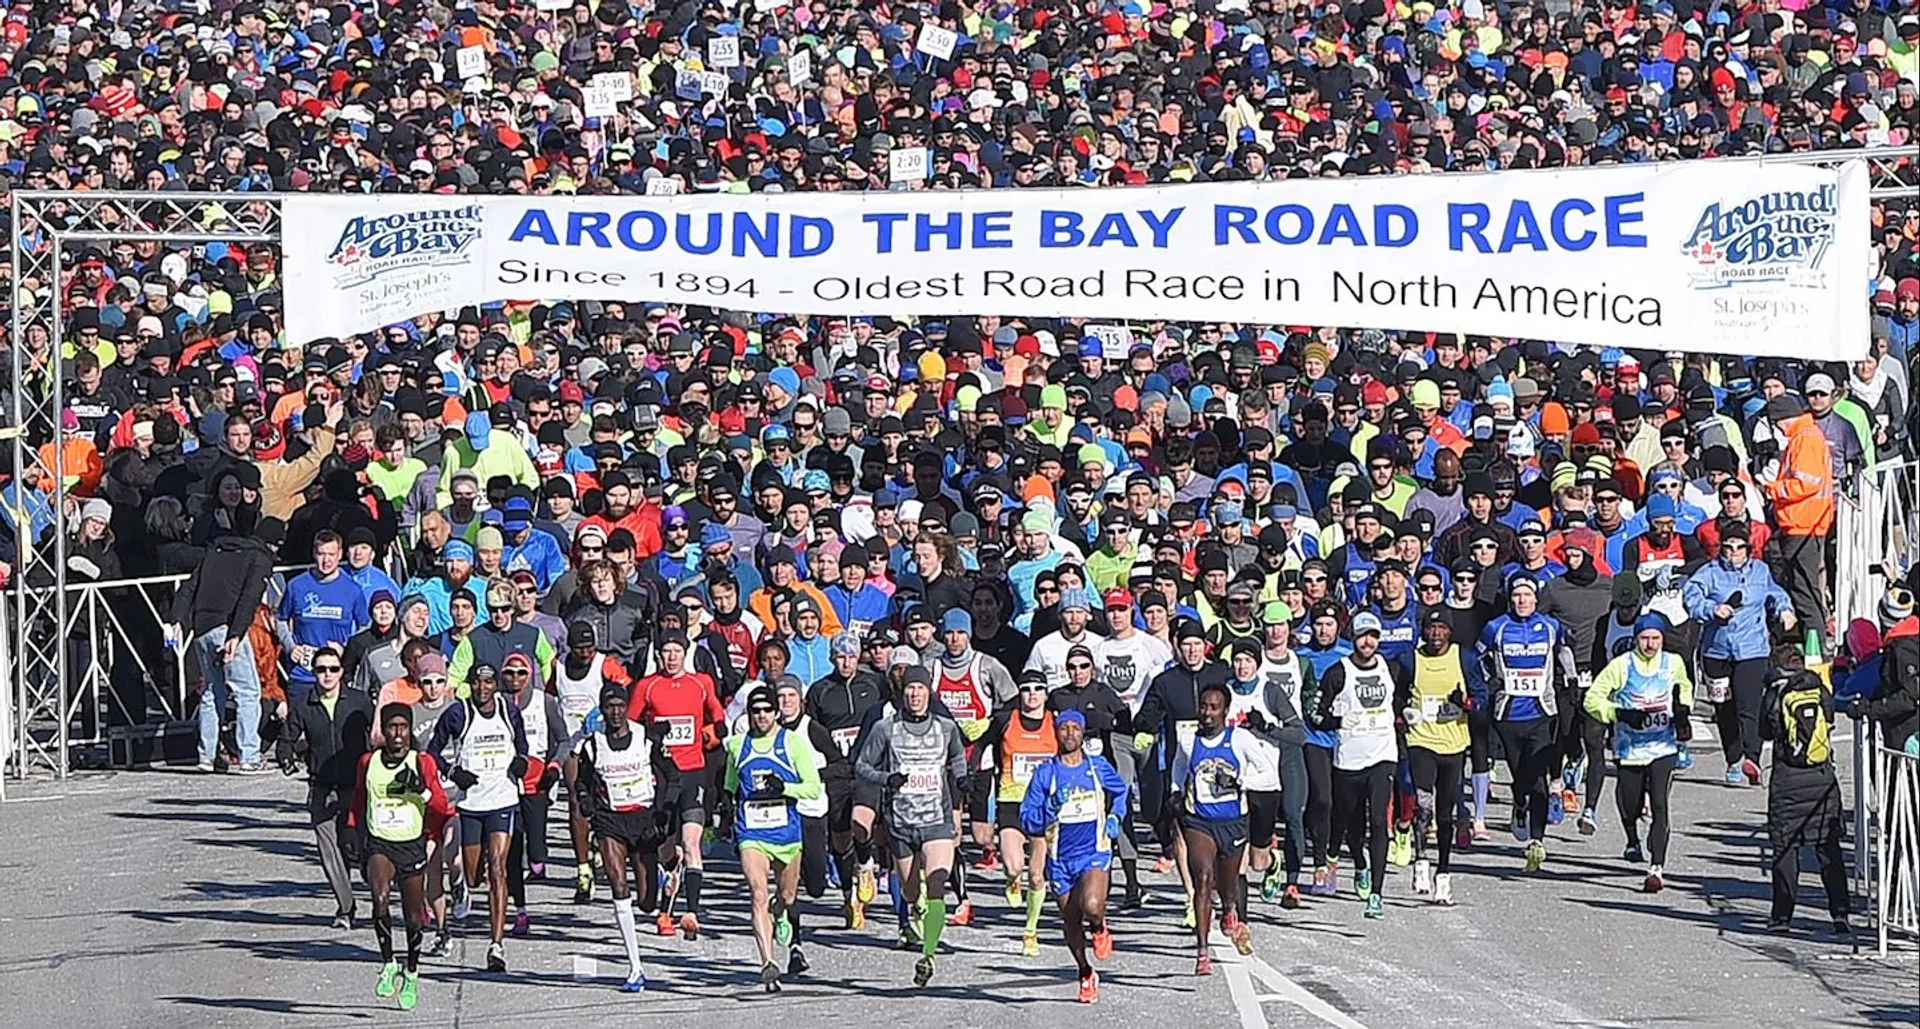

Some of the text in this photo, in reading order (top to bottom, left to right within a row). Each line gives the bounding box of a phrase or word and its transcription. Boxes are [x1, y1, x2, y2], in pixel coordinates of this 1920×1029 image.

[897, 155, 922, 168] 2:20
[1683, 184, 1834, 248] Around
[1775, 214, 1818, 234] the
[328, 204, 478, 260] Around
[508, 192, 1648, 258] AROUND THE BAY ROAD RACE
[369, 227, 473, 259] Bay
[1726, 222, 1827, 269] Bay
[365, 254, 436, 272] ROAD RACE
[1721, 266, 1790, 279] ROAD RACE
[360, 289, 379, 305] St.
[498, 259, 627, 287] Since
[650, 271, 760, 299] 1894
[813, 271, 964, 301] Oldest
[983, 269, 1105, 298] Road
[1126, 269, 1245, 300] Race
[1264, 269, 1300, 301] in
[1333, 270, 1457, 309] North
[1473, 278, 1663, 327] America
[1714, 297, 1734, 314] St.
[1512, 678, 1538, 691] 151
[484, 757, 496, 768] 11
[388, 810, 396, 820] 3
[763, 809, 769, 819] 4
